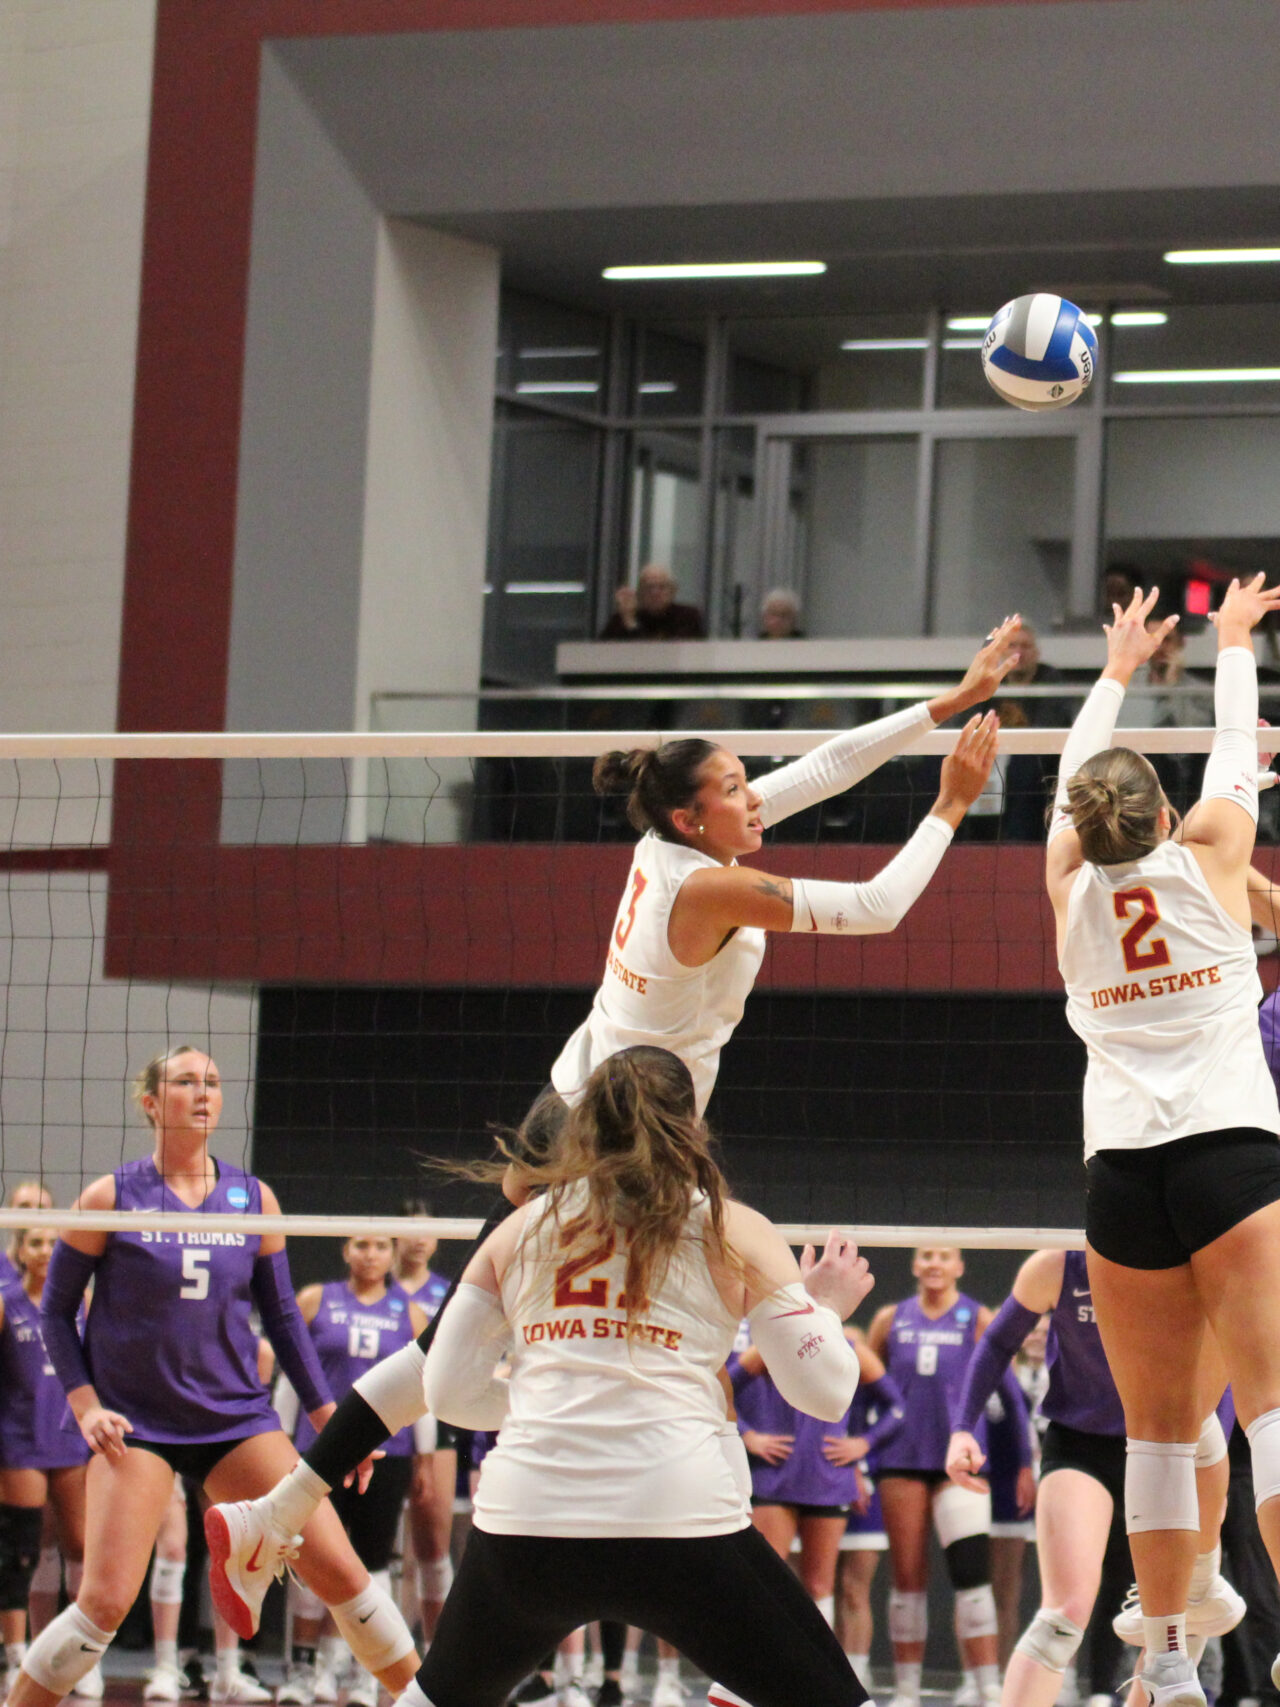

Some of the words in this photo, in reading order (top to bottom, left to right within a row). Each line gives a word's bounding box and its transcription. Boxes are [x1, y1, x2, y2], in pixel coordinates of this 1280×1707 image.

[615, 867, 648, 951] 3
[1113, 886, 1173, 974] 2
[612, 958, 648, 995] STATE
[1090, 981, 1147, 1009] IOWA
[1148, 965, 1222, 997] STATE
[177, 1231, 247, 1247] THOMAS
[180, 1249, 211, 1300] 5
[348, 1326, 380, 1360] 13
[522, 1318, 588, 1346] IOWA
[592, 1317, 683, 1352] STATE
[915, 1345, 938, 1377] 8
